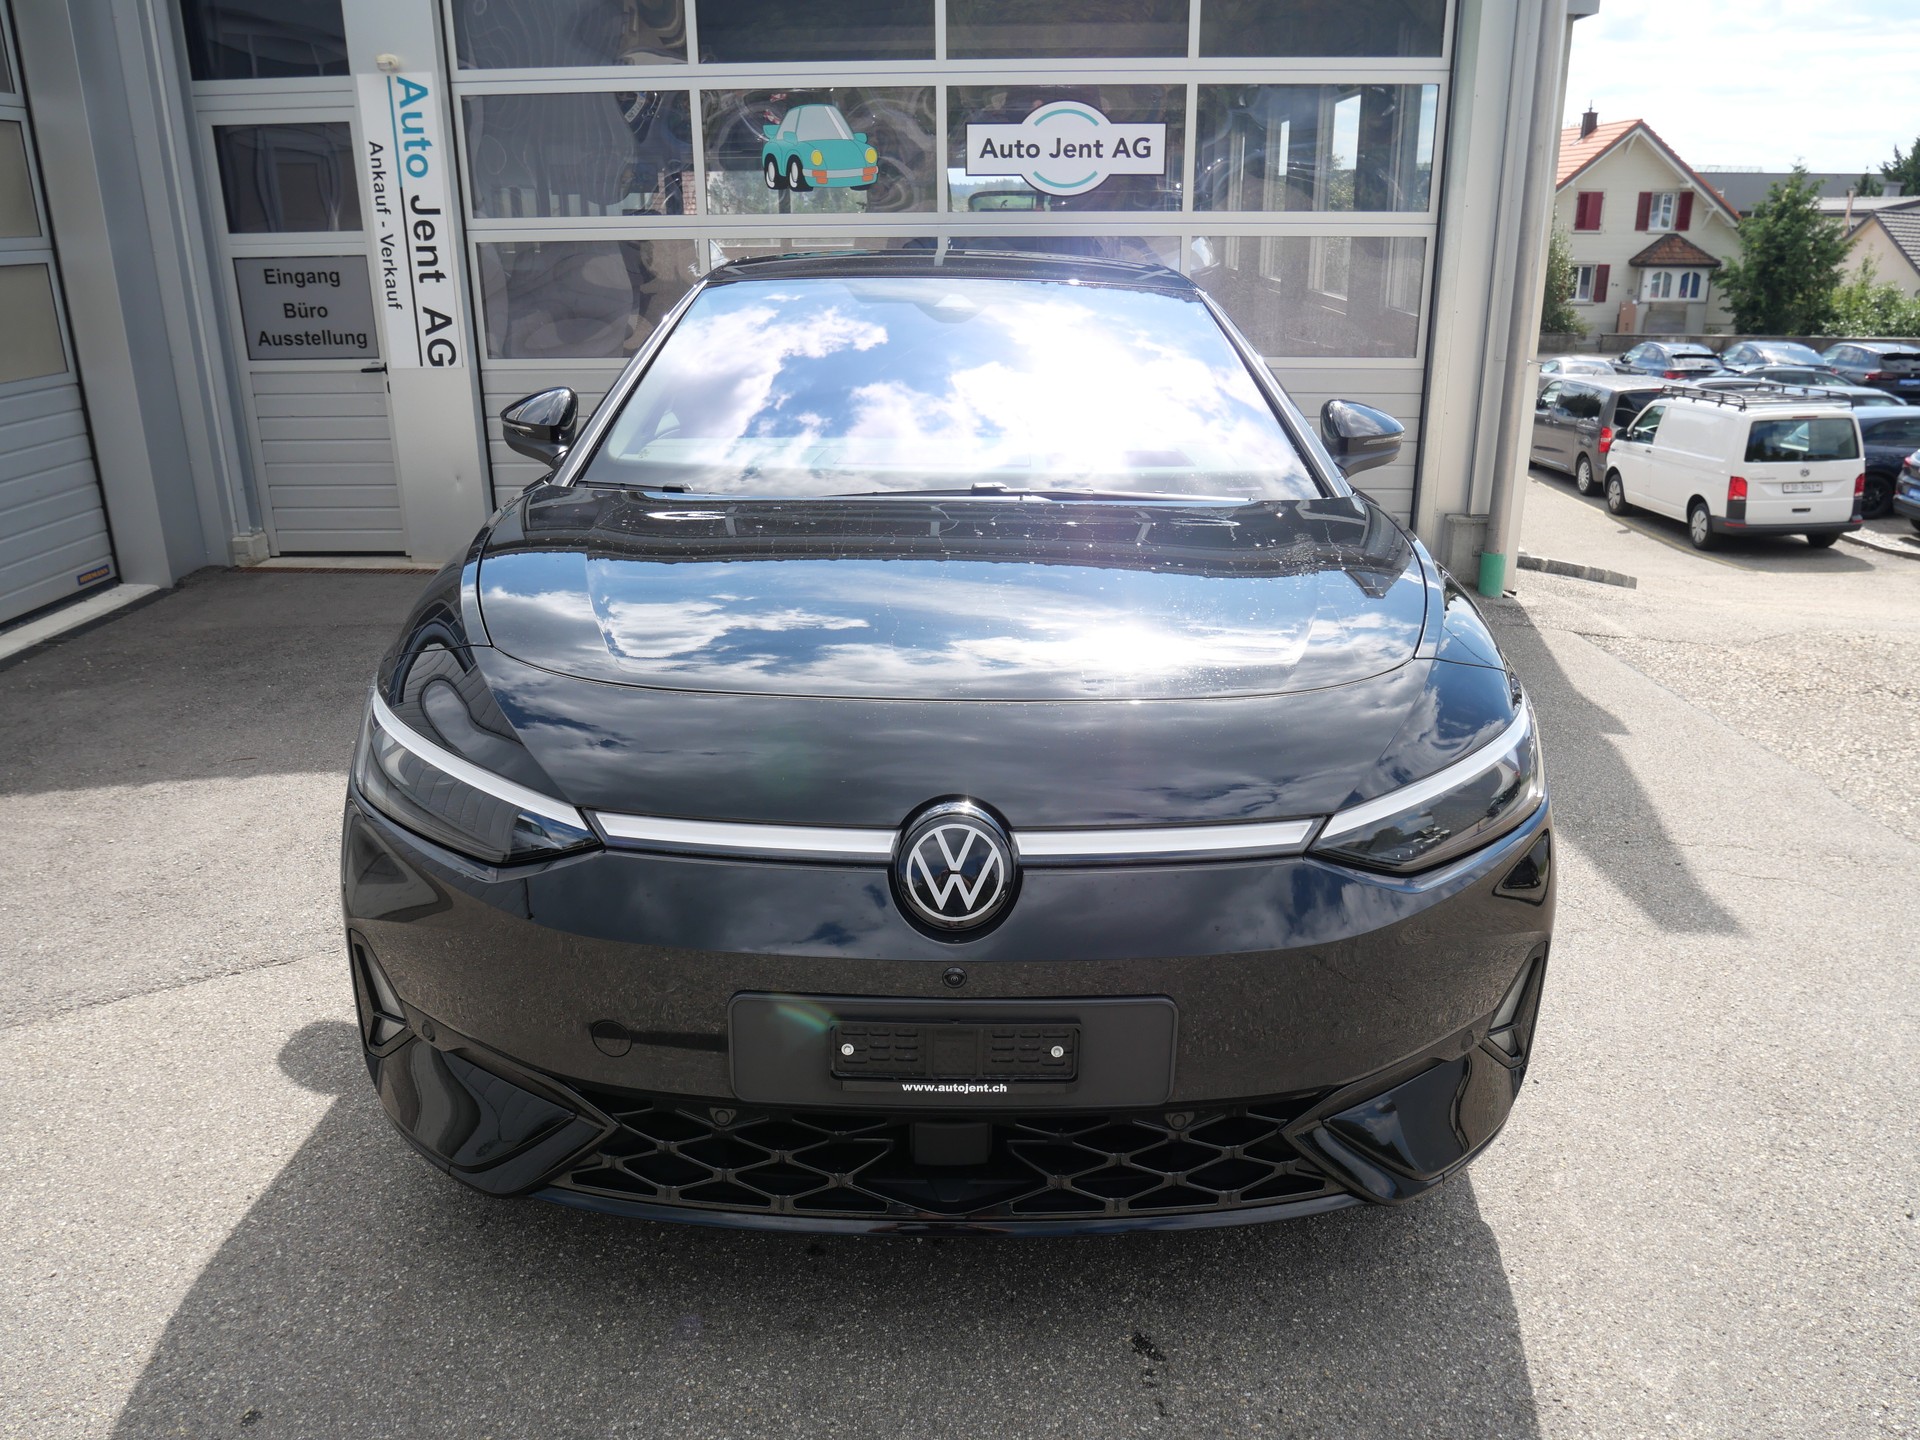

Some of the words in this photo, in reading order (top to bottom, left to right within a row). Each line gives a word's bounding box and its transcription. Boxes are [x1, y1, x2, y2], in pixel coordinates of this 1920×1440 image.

[396, 76, 433, 179] Auto
[980, 138, 1041, 158] Auto
[1048, 138, 1104, 159] Jent
[1111, 137, 1152, 158] AG
[368, 141, 392, 216] Ankauf
[410, 194, 447, 284] Jent
[263, 268, 341, 287] Eingang
[379, 233, 403, 310] Verkauf
[283, 302, 328, 319] Büro
[258, 330, 368, 348] Ausstellung
[422, 306, 457, 367] AG
[901, 1083, 1008, 1095] www.autojent.ch
